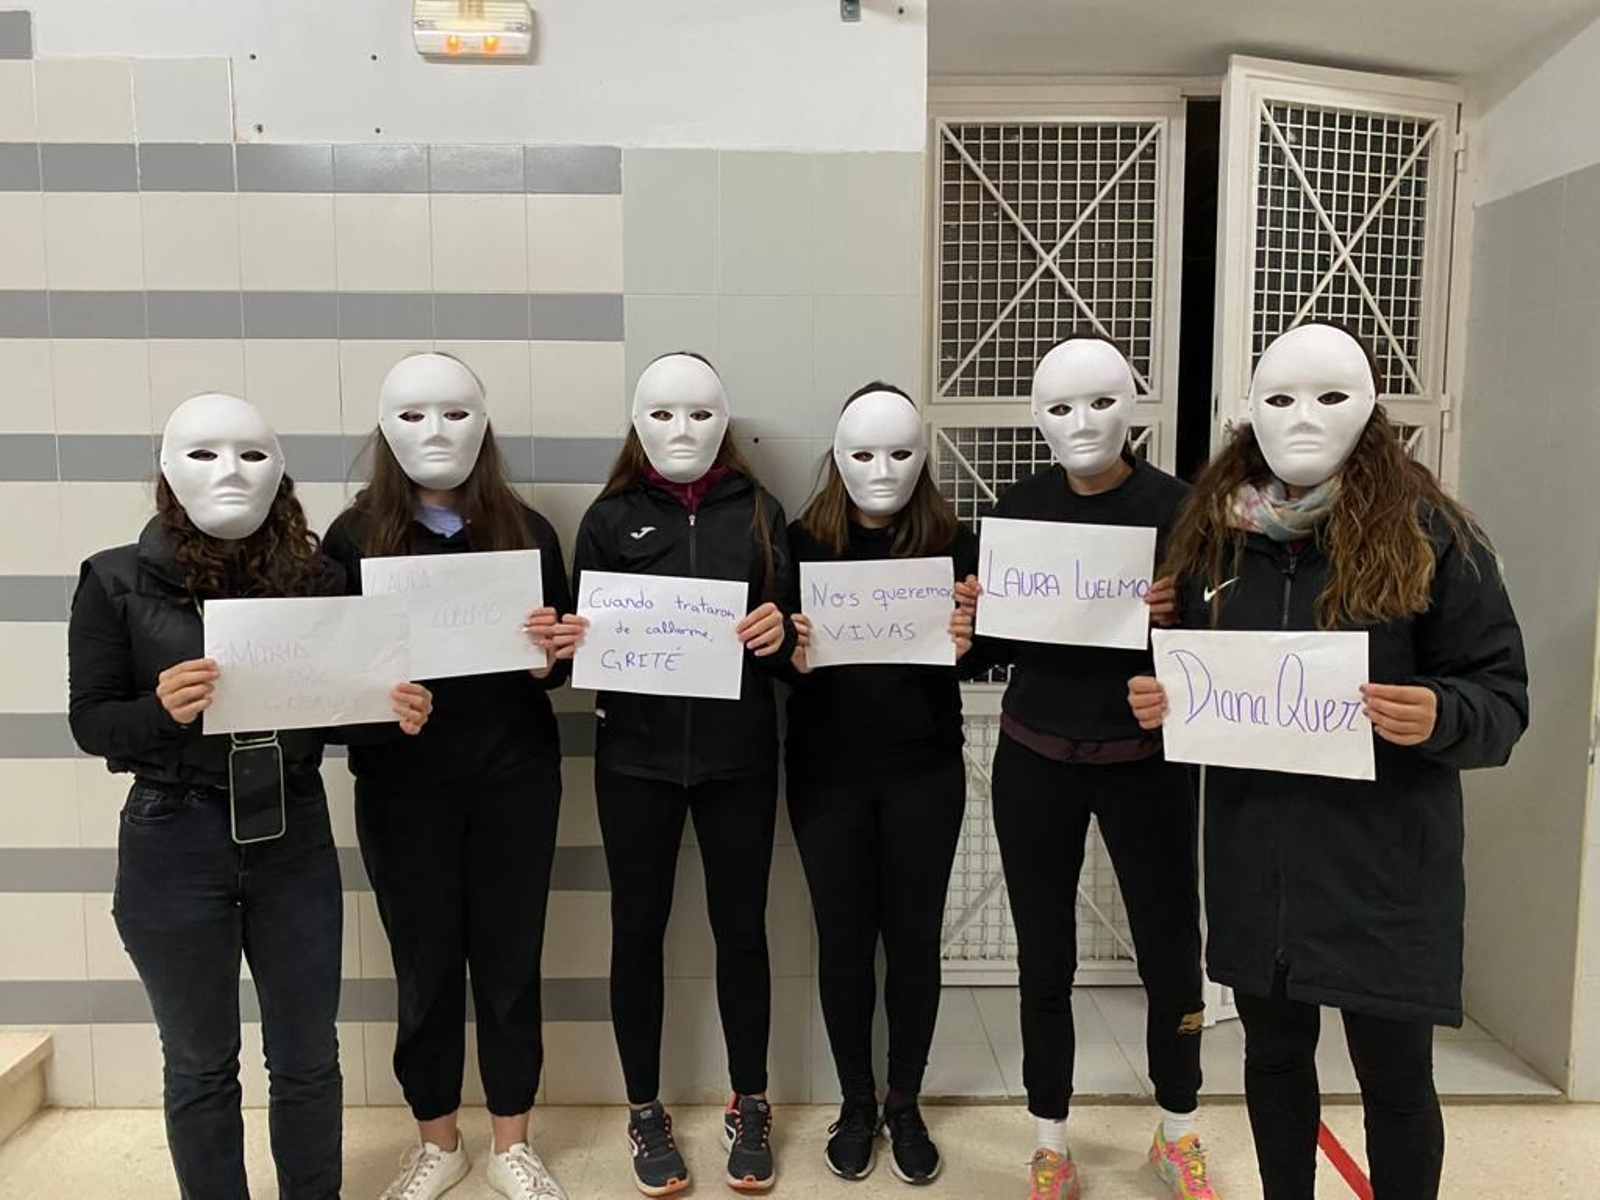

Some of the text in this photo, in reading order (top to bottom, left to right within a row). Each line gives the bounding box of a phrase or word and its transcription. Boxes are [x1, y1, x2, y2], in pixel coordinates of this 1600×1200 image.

[986, 549, 1151, 600] LAURA LUELMO
[588, 587, 735, 620] Cuando trataron
[811, 582, 954, 611] Nos queremo
[614, 619, 631, 635] de
[822, 622, 917, 641] VIVAS
[600, 646, 686, 671] GRITÉ
[1168, 649, 1361, 733] Diana Quer
